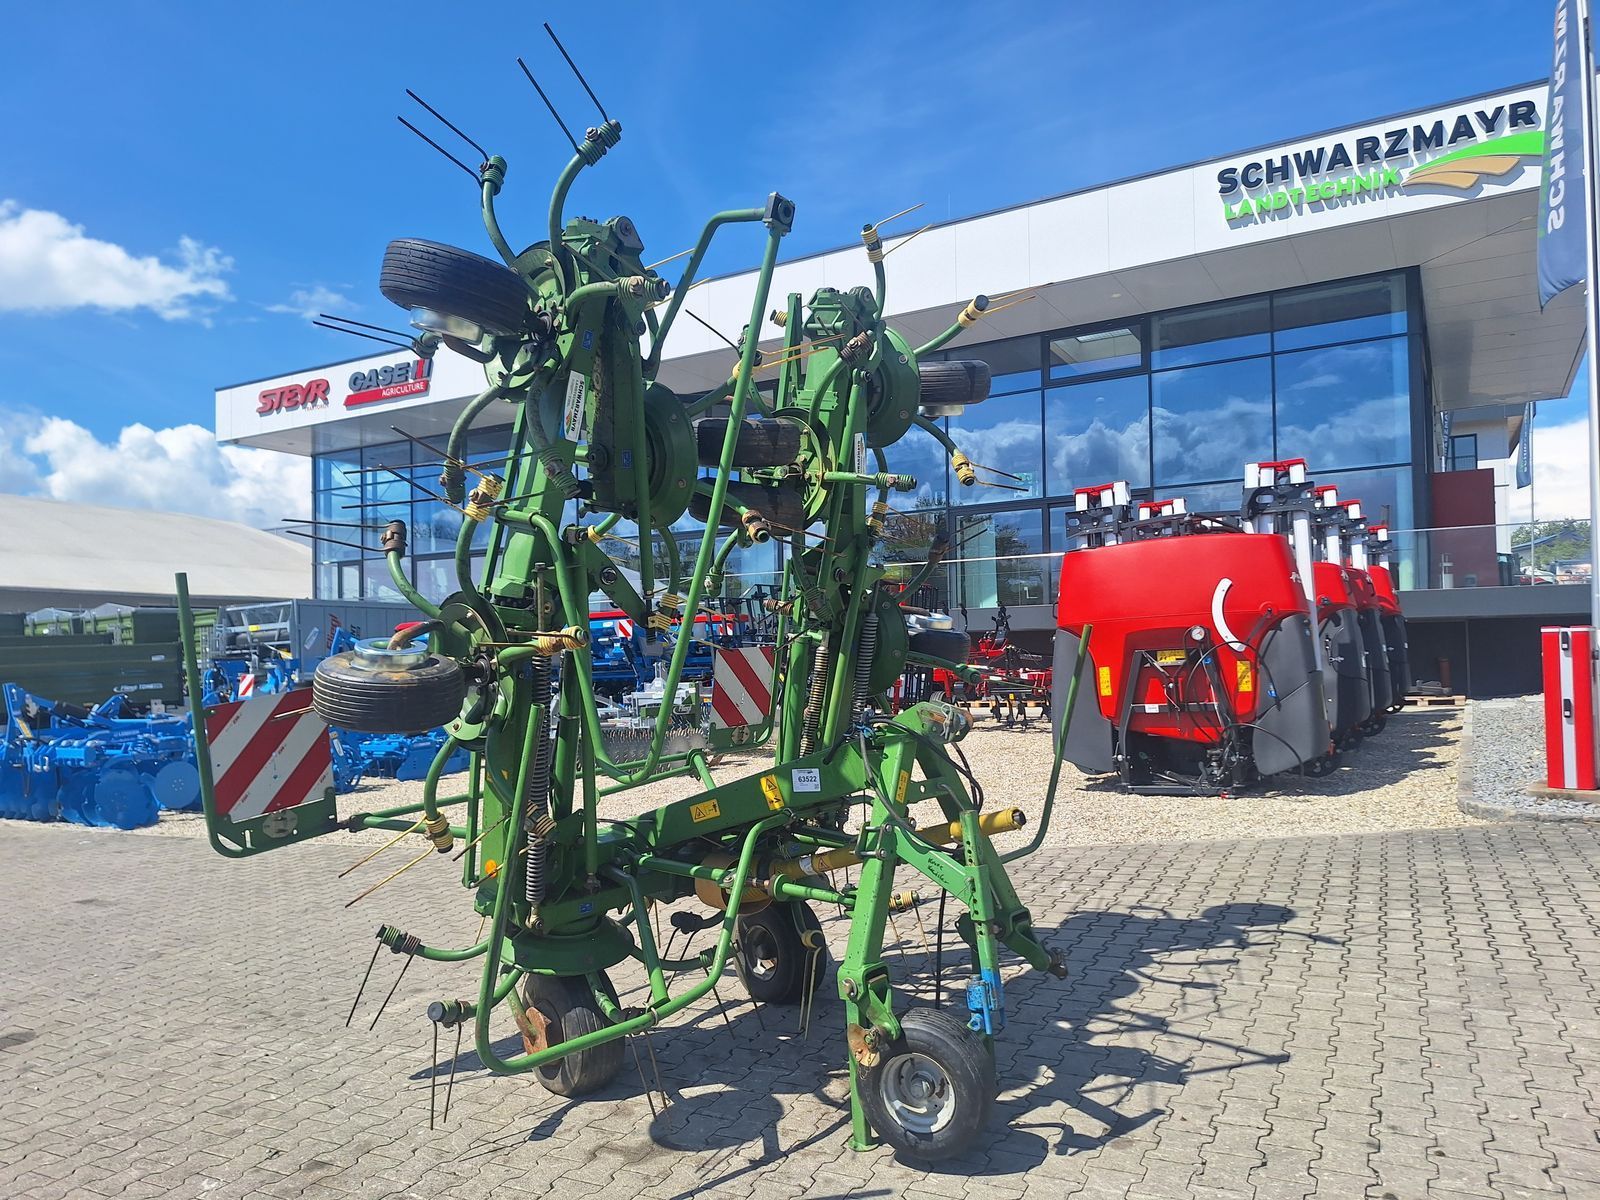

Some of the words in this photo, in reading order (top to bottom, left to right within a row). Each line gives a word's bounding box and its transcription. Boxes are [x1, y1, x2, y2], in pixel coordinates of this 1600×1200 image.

[1217, 100, 1536, 194] SCHWARZMAYR
[1225, 166, 1400, 220] LANDTECHNIK
[349, 362, 410, 391] CASE
[382, 382, 424, 396] AGRICULTURE
[256, 379, 330, 413] STEYR
[571, 380, 584, 432] SCHWARZMAYR
[798, 775, 817, 783] 63522
